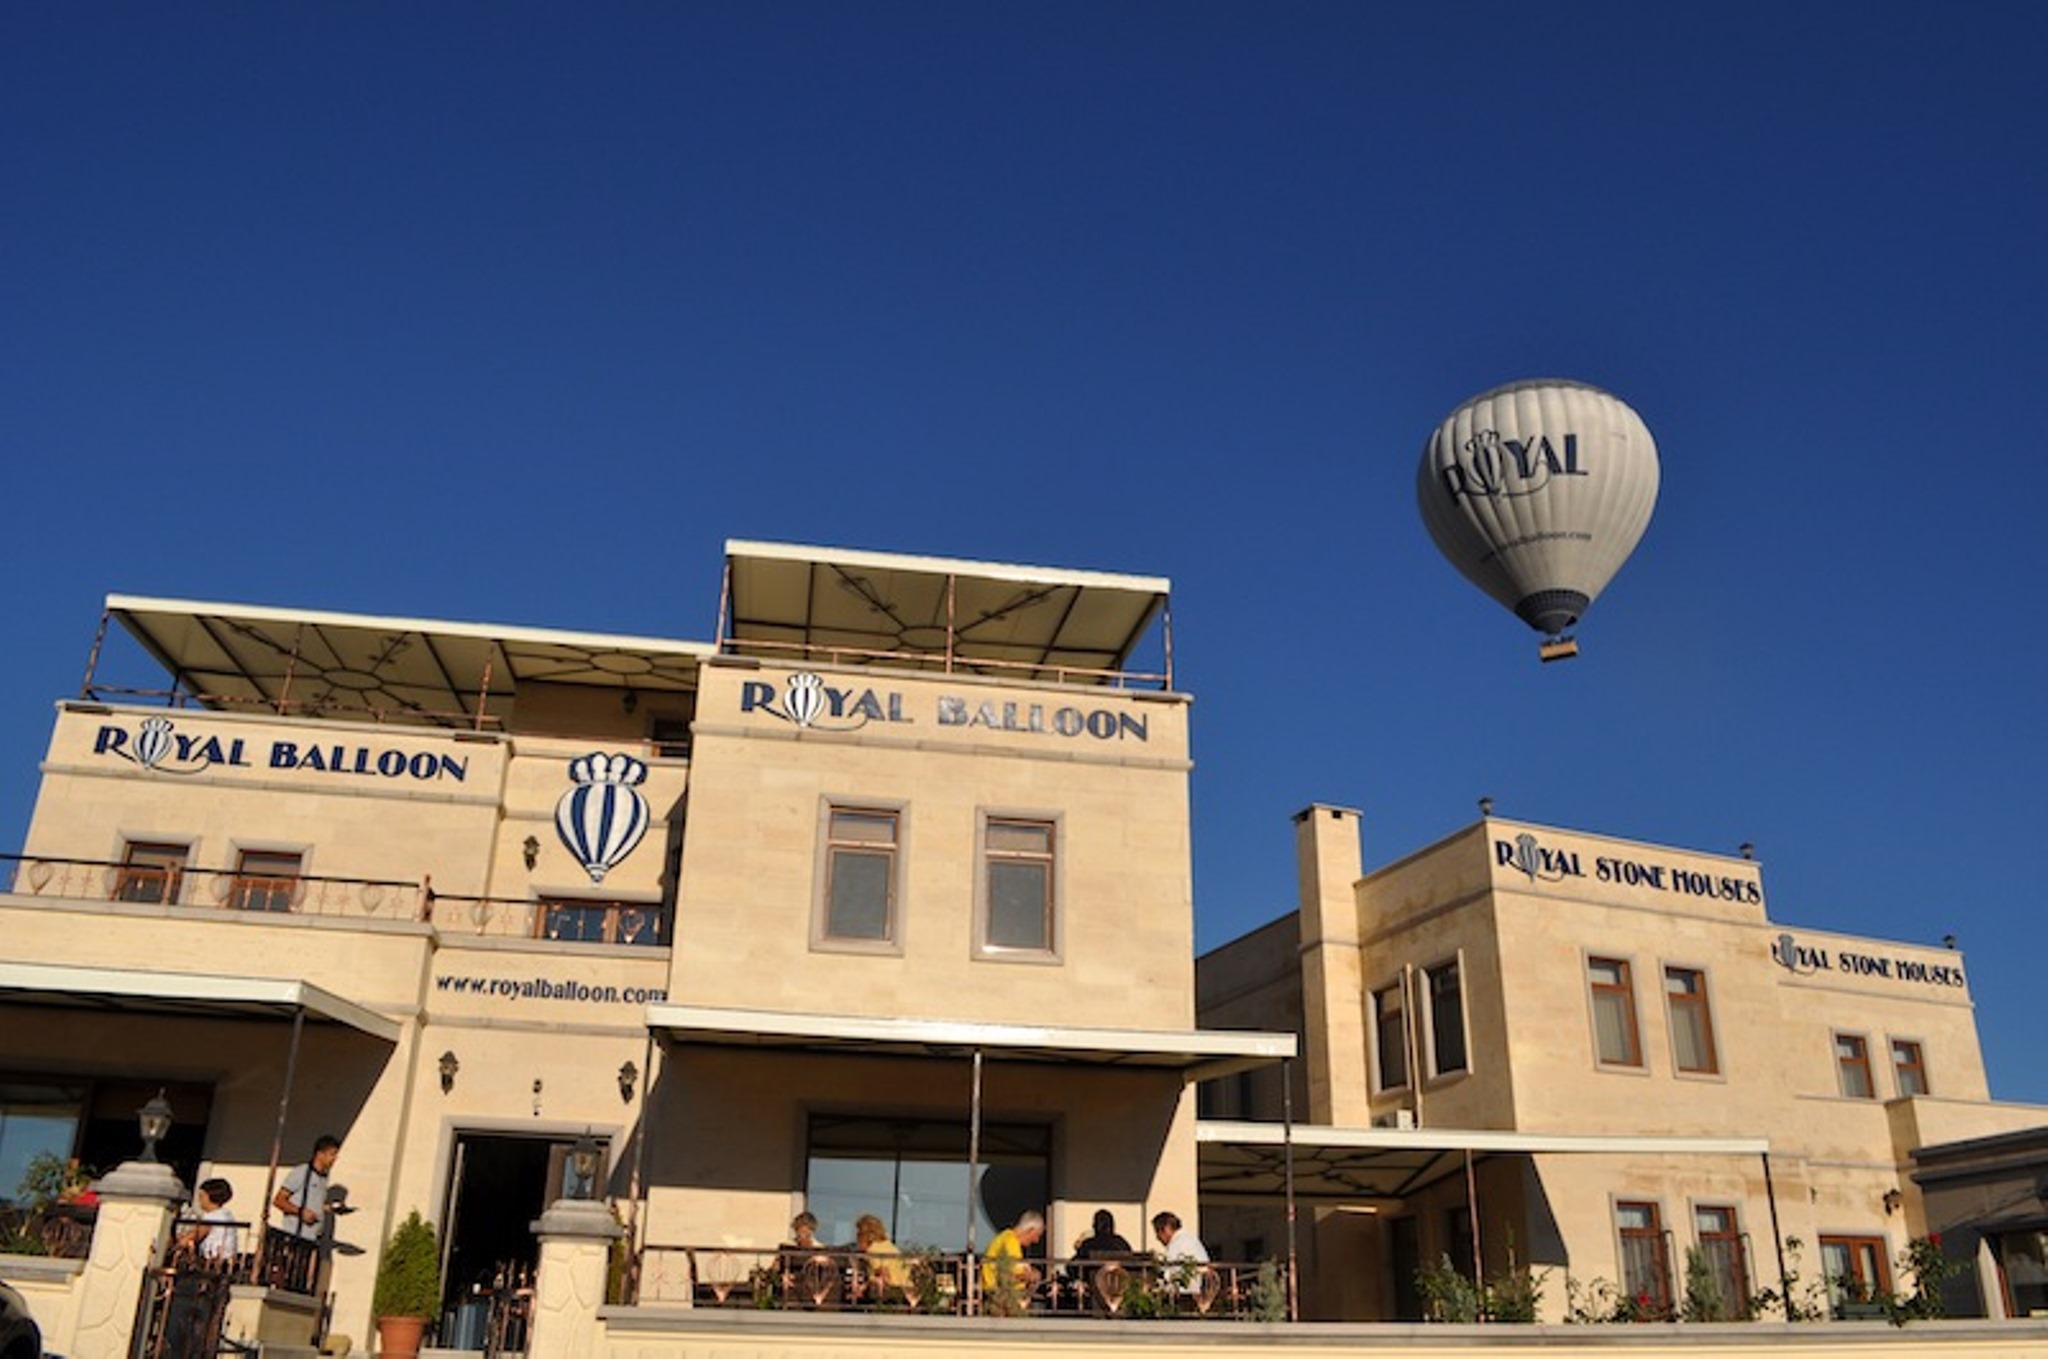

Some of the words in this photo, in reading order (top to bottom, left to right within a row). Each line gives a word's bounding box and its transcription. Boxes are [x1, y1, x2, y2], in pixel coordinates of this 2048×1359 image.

[1442, 430, 1589, 504] ROYAL
[740, 673, 914, 732] ROYAL
[937, 695, 1147, 742] BALLOON
[93, 715, 252, 774] ROYAL
[268, 741, 468, 782] BALLOON
[1495, 833, 1587, 883] ROYAL
[1595, 856, 1667, 891] STONE
[1672, 867, 1762, 905] HOUSES
[436, 974, 667, 1004] www.royalballoon.com
[1839, 952, 1891, 979] STONE
[1896, 960, 1964, 987] HOUSES
